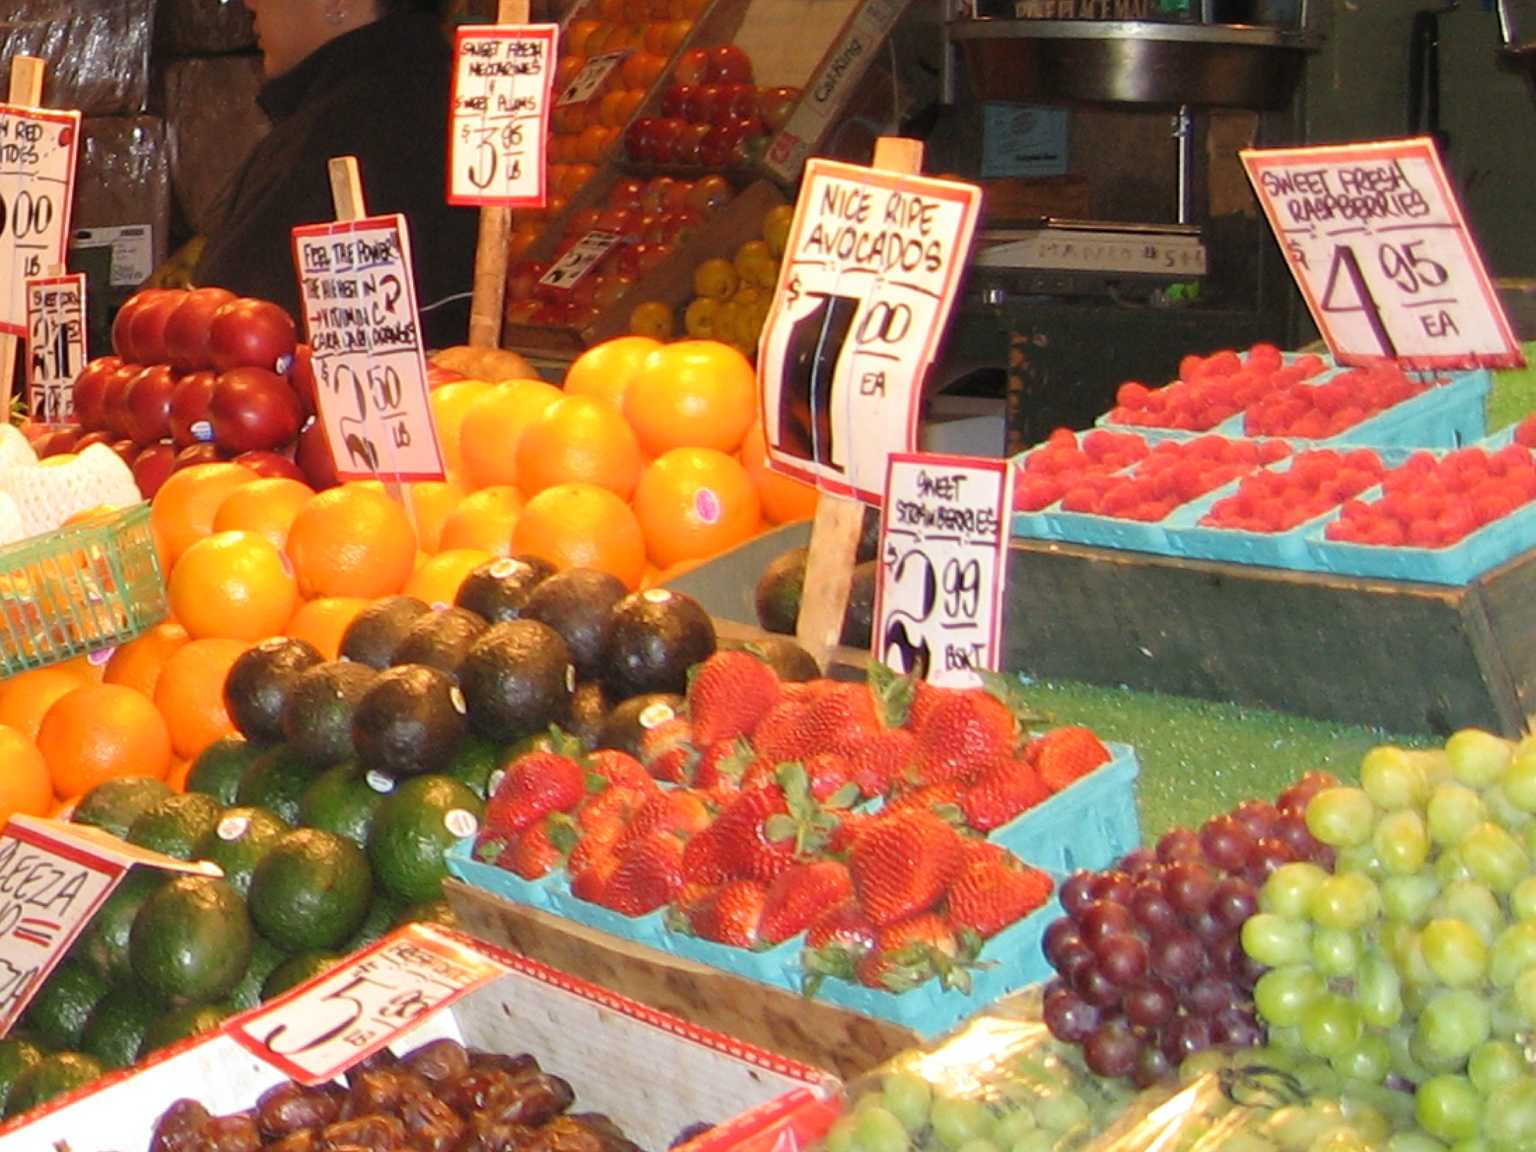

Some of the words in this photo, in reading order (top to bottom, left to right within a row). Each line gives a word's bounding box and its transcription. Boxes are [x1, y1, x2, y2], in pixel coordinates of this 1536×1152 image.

[15, 120, 43, 142] RED
[1261, 168, 1332, 198] SWEET
[1338, 159, 1416, 194] FRESH
[820, 183, 873, 224] NICE
[884, 192, 942, 236] RIPE
[1286, 189, 1431, 223] RASPBERRIES
[803, 223, 943, 274] AVOCADOS
[1419, 310, 1460, 338] EA
[859, 370, 886, 398] EA
